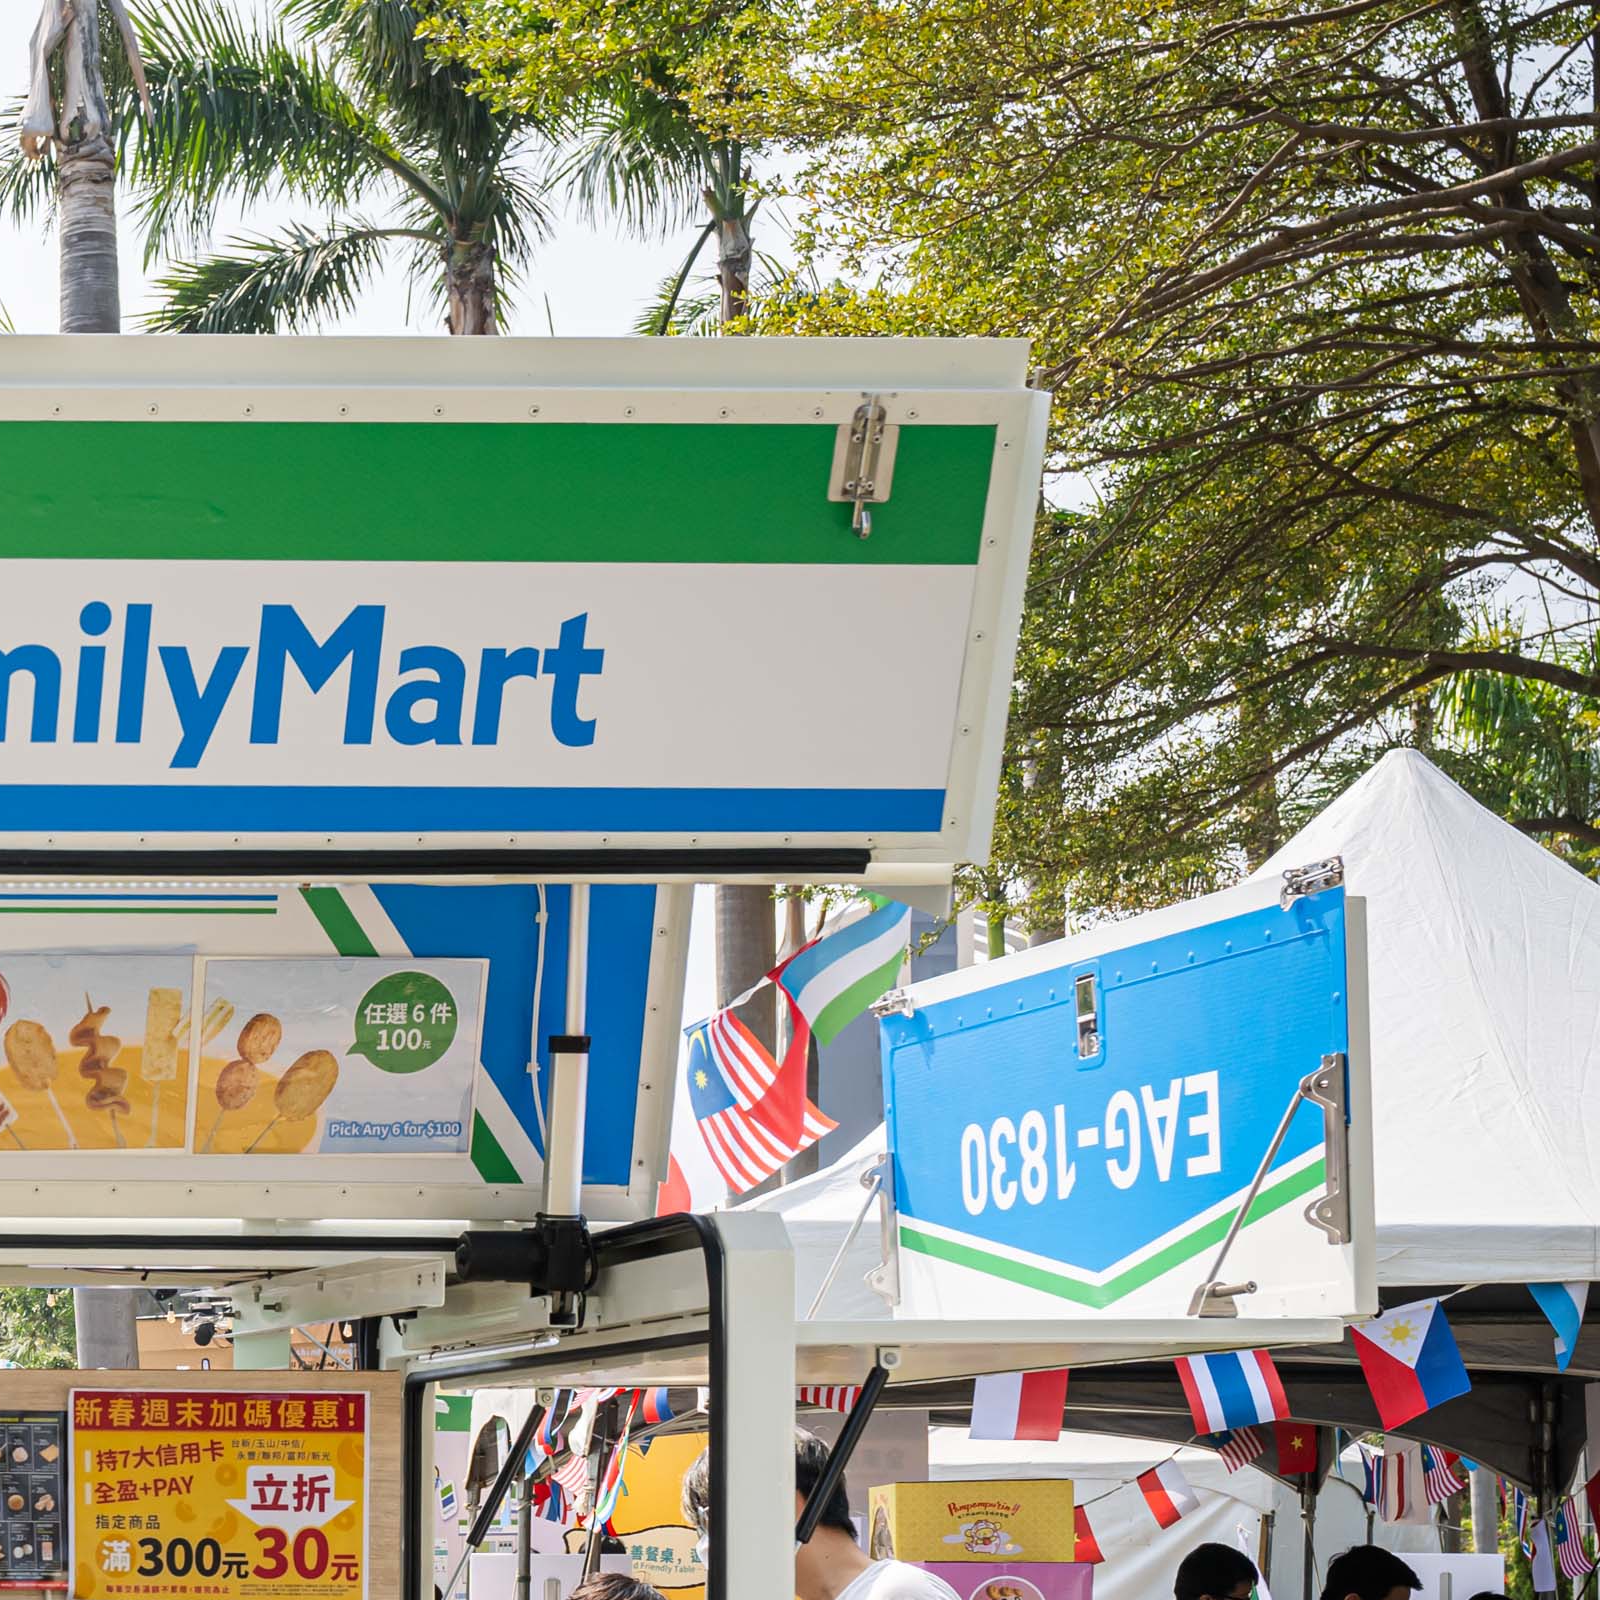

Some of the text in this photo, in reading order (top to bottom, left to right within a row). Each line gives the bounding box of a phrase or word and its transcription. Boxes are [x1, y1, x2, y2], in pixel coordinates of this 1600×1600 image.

[376, 1028, 431, 1051] 100元
[331, 1123, 460, 1140] Pick Any 6 for $100
[960, 1070, 1222, 1215] EAG-1830
[75, 1397, 355, 1428] 新春週末加碼優惠！
[96, 1440, 224, 1473] 持7大信用卡
[95, 1476, 194, 1505] 全盈+PAY
[251, 1473, 331, 1513] 立折
[95, 1514, 160, 1530] 指定商品
[102, 1537, 249, 1580] 滿 300元
[252, 1527, 358, 1582] 30元
